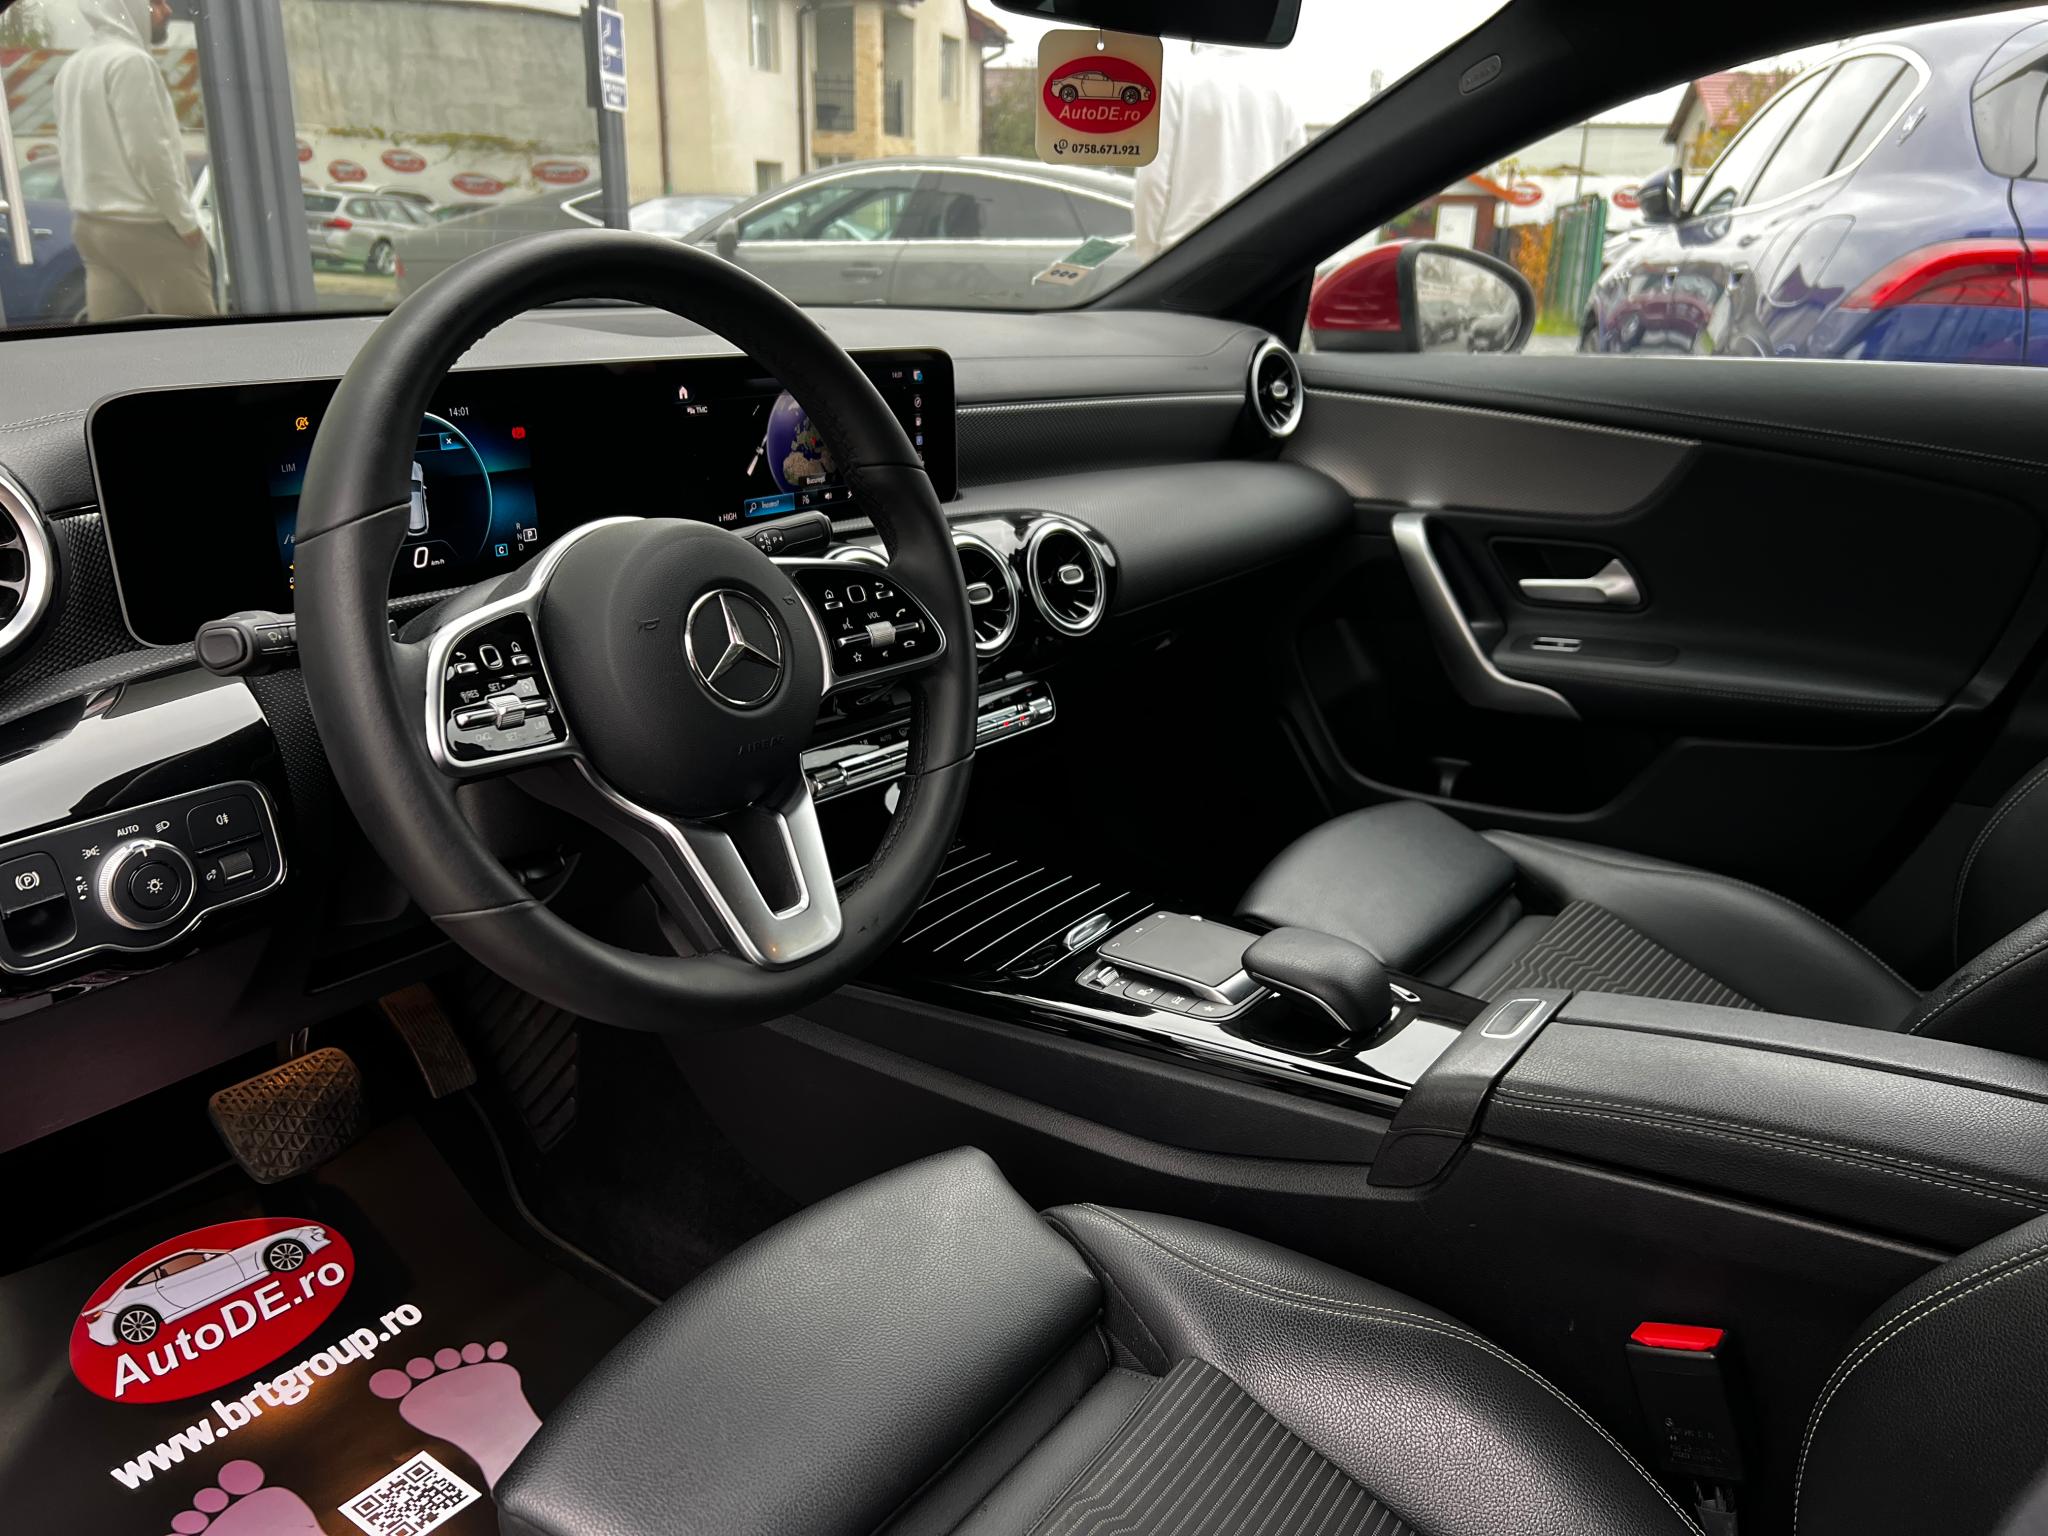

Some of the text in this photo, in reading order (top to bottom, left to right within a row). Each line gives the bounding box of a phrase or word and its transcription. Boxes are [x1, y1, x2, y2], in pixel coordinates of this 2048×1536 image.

[1058, 104, 1141, 122] AutoDE.ro
[1071, 143, 1140, 155] 0758.671.921
[449, 406, 469, 417] 14:01
[281, 463, 296, 473] LIM
[723, 512, 737, 521] HIGH
[516, 532, 523, 540] N
[518, 543, 524, 551] D
[413, 546, 429, 569] 0
[867, 611, 880, 620] VOL
[116, 824, 140, 837] AUTO
[114, 1262, 346, 1397] AutoDE.ro
[110, 1303, 423, 1490] www.brtgroup.ro
